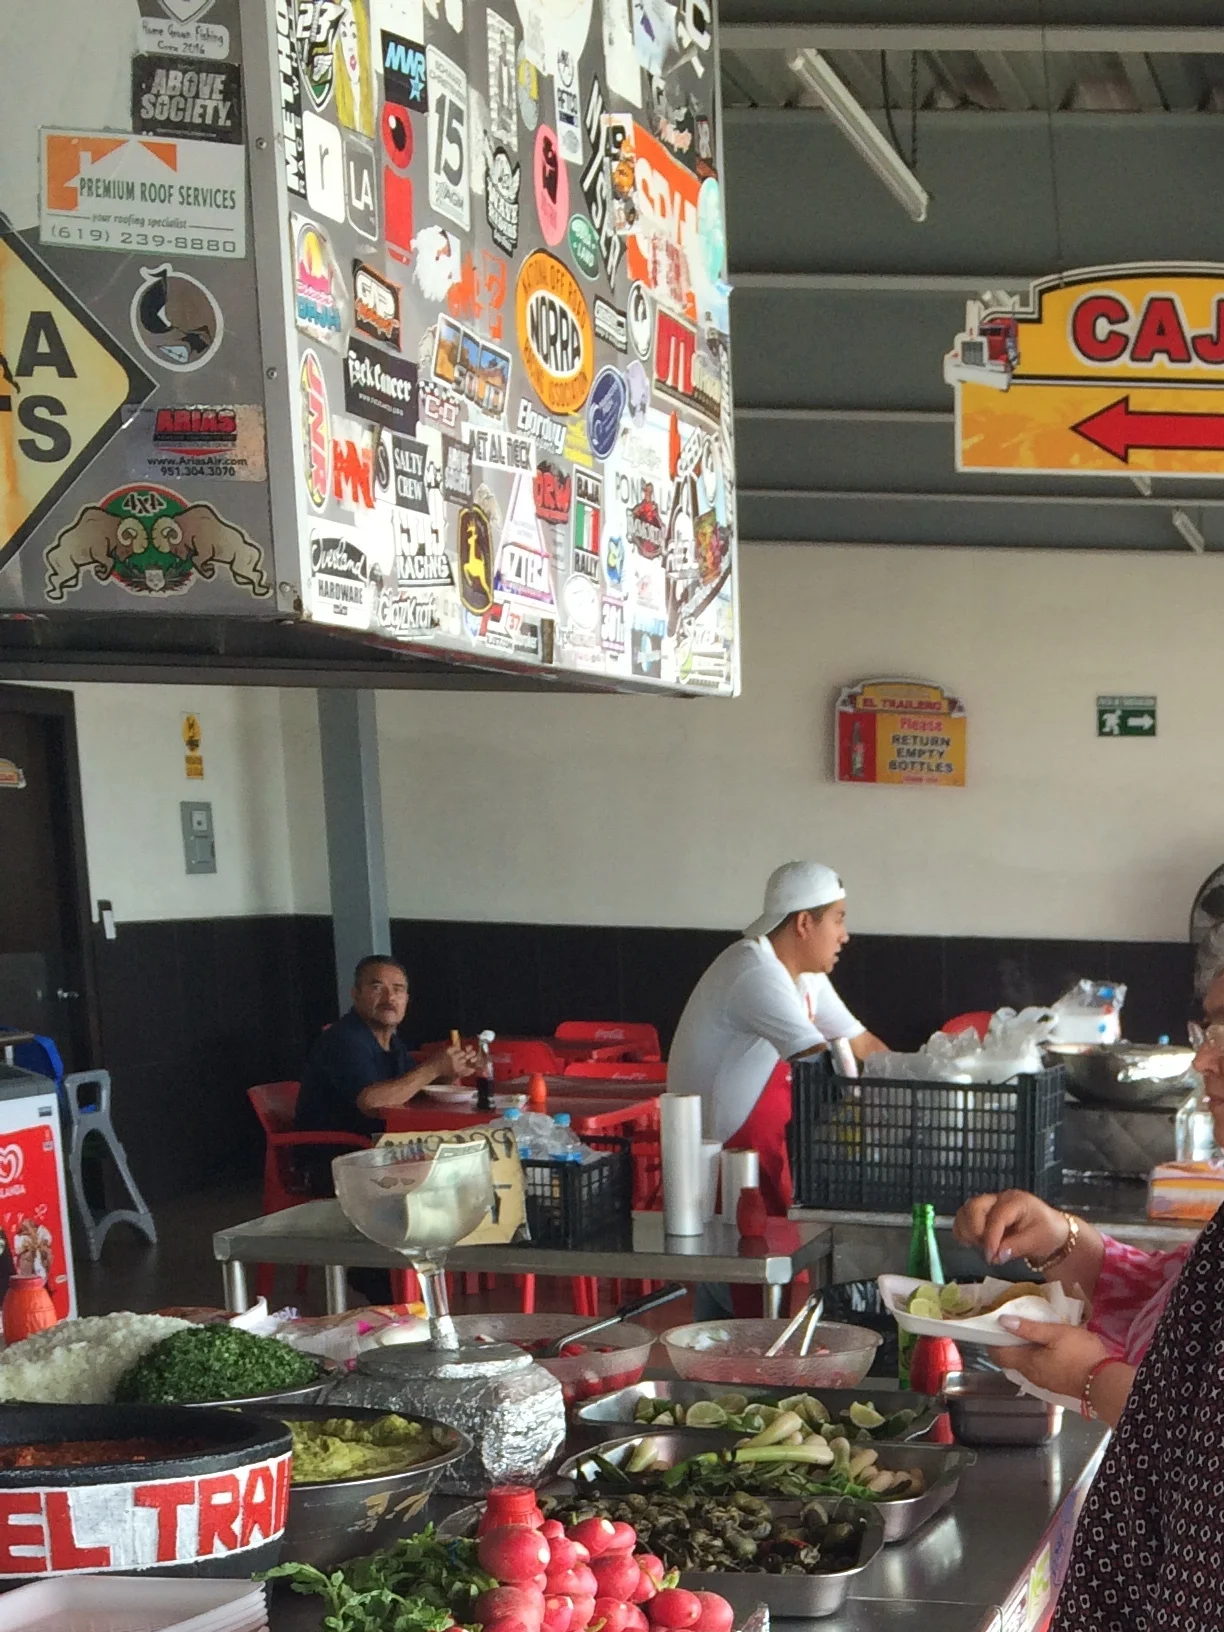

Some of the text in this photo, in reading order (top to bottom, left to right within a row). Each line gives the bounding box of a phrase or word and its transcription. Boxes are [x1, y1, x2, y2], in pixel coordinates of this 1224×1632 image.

[151, 69, 227, 101] ABOVE
[434, 93, 466, 187] 15
[79, 177, 237, 210] PREMIUM ROOF SERVICES
[350, 161, 374, 211] LA
[51, 224, 237, 253] (619) 239-8880
[15, 311, 78, 378] A
[529, 296, 581, 373] NORRA
[18, 395, 71, 462] S
[155, 408, 237, 433] ARIAS
[147, 456, 248, 467] www.AriasAir.com
[160, 466, 236, 478] 951.304.3070
[395, 447, 424, 474] SALTY
[398, 475, 424, 502] CREW
[124, 492, 165, 515] 4x4
[398, 555, 450, 580] RACING
[318, 578, 364, 604] HARDWARE
[892, 734, 951, 747] RETURN
[897, 748, 945, 760] EMPTY
[889, 760, 953, 773] BOTTLES
[0, 1457, 292, 1574] EL TRAI
